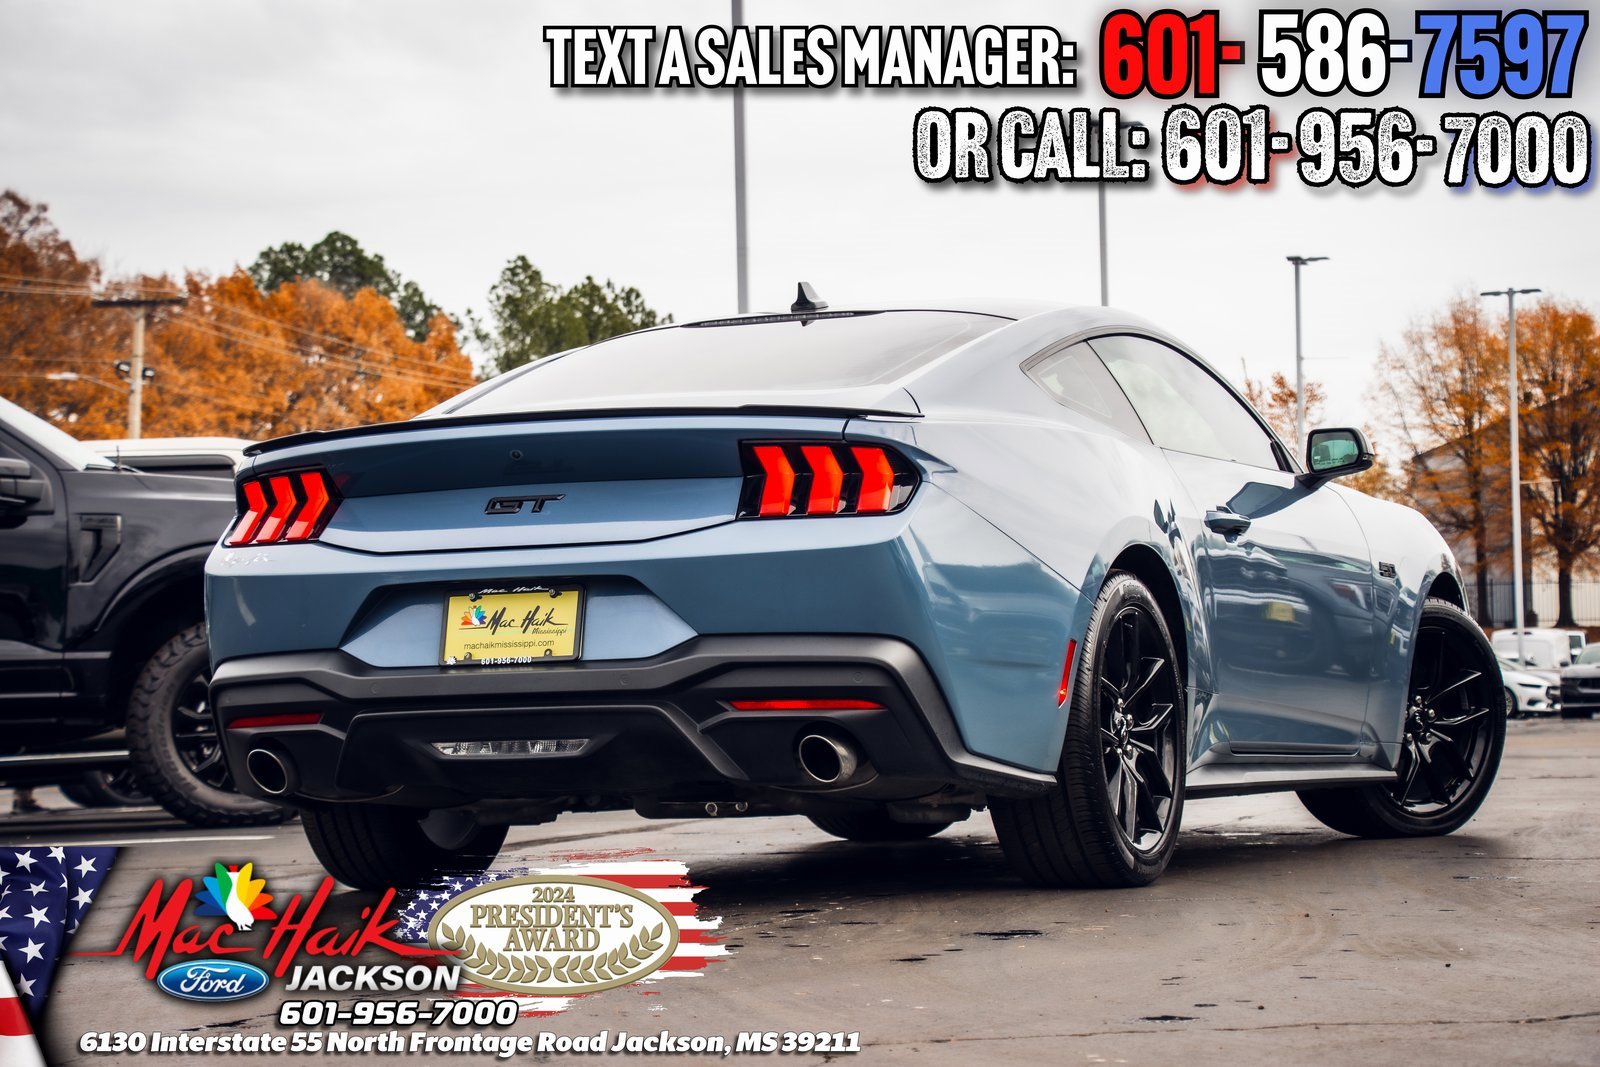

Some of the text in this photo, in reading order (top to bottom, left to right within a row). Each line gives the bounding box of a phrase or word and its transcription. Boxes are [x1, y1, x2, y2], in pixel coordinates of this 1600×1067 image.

[484, 494, 566, 515] GT
[470, 605, 567, 635] Mac Haik
[532, 627, 567, 636] Mississippi
[463, 640, 555, 650] machaikmississippi.com
[480, 656, 532, 665] 601-956-7000
